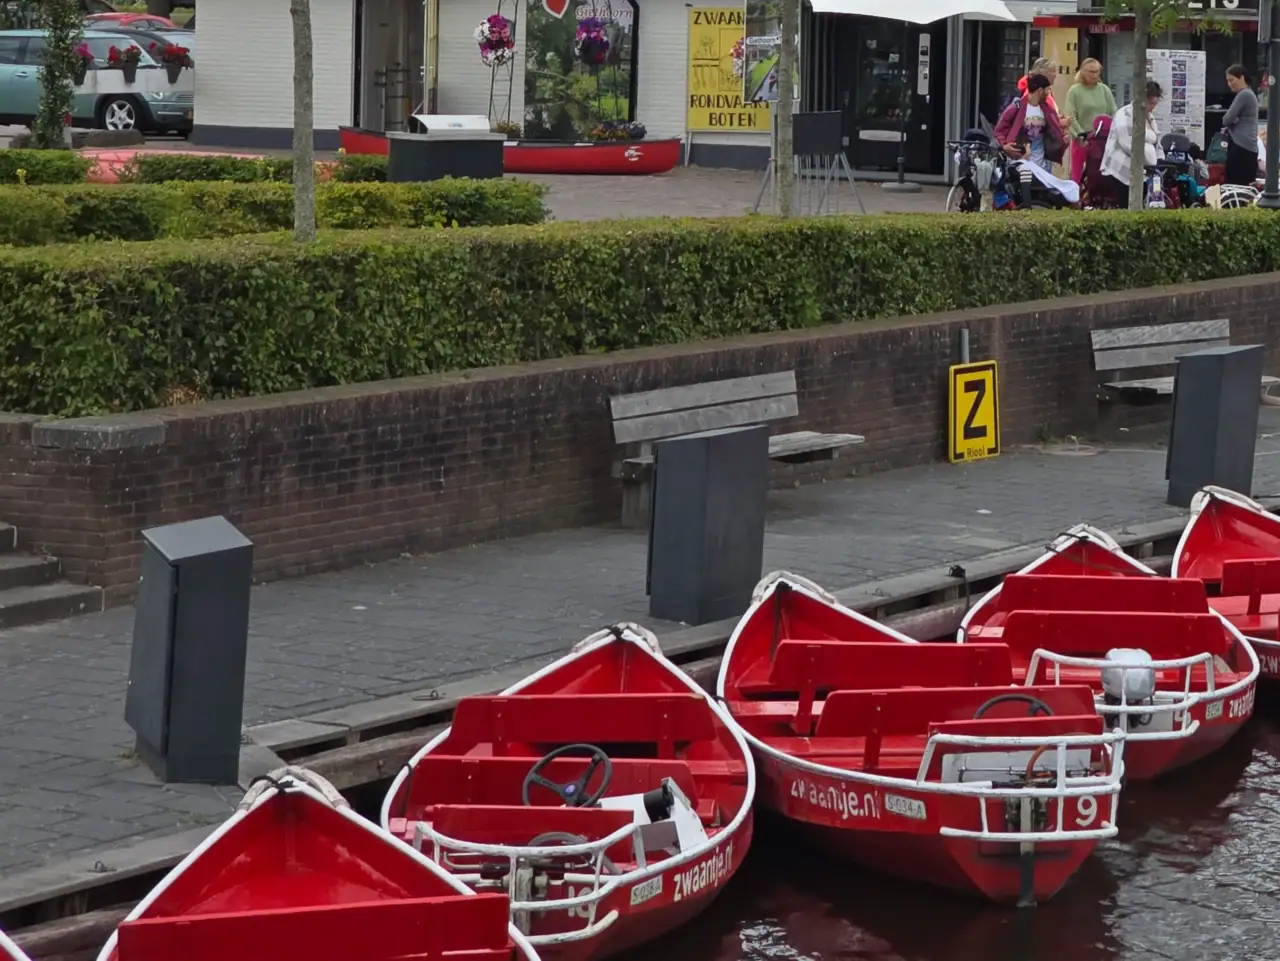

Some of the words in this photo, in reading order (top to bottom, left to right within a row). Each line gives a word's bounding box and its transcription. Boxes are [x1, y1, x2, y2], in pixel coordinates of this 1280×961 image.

[708, 112, 757, 127] BOTEN
[963, 379, 988, 440] Z
[966, 446, 986, 458] Riool
[1075, 794, 1098, 826] 9
[673, 840, 733, 902] zwaantje.nl
